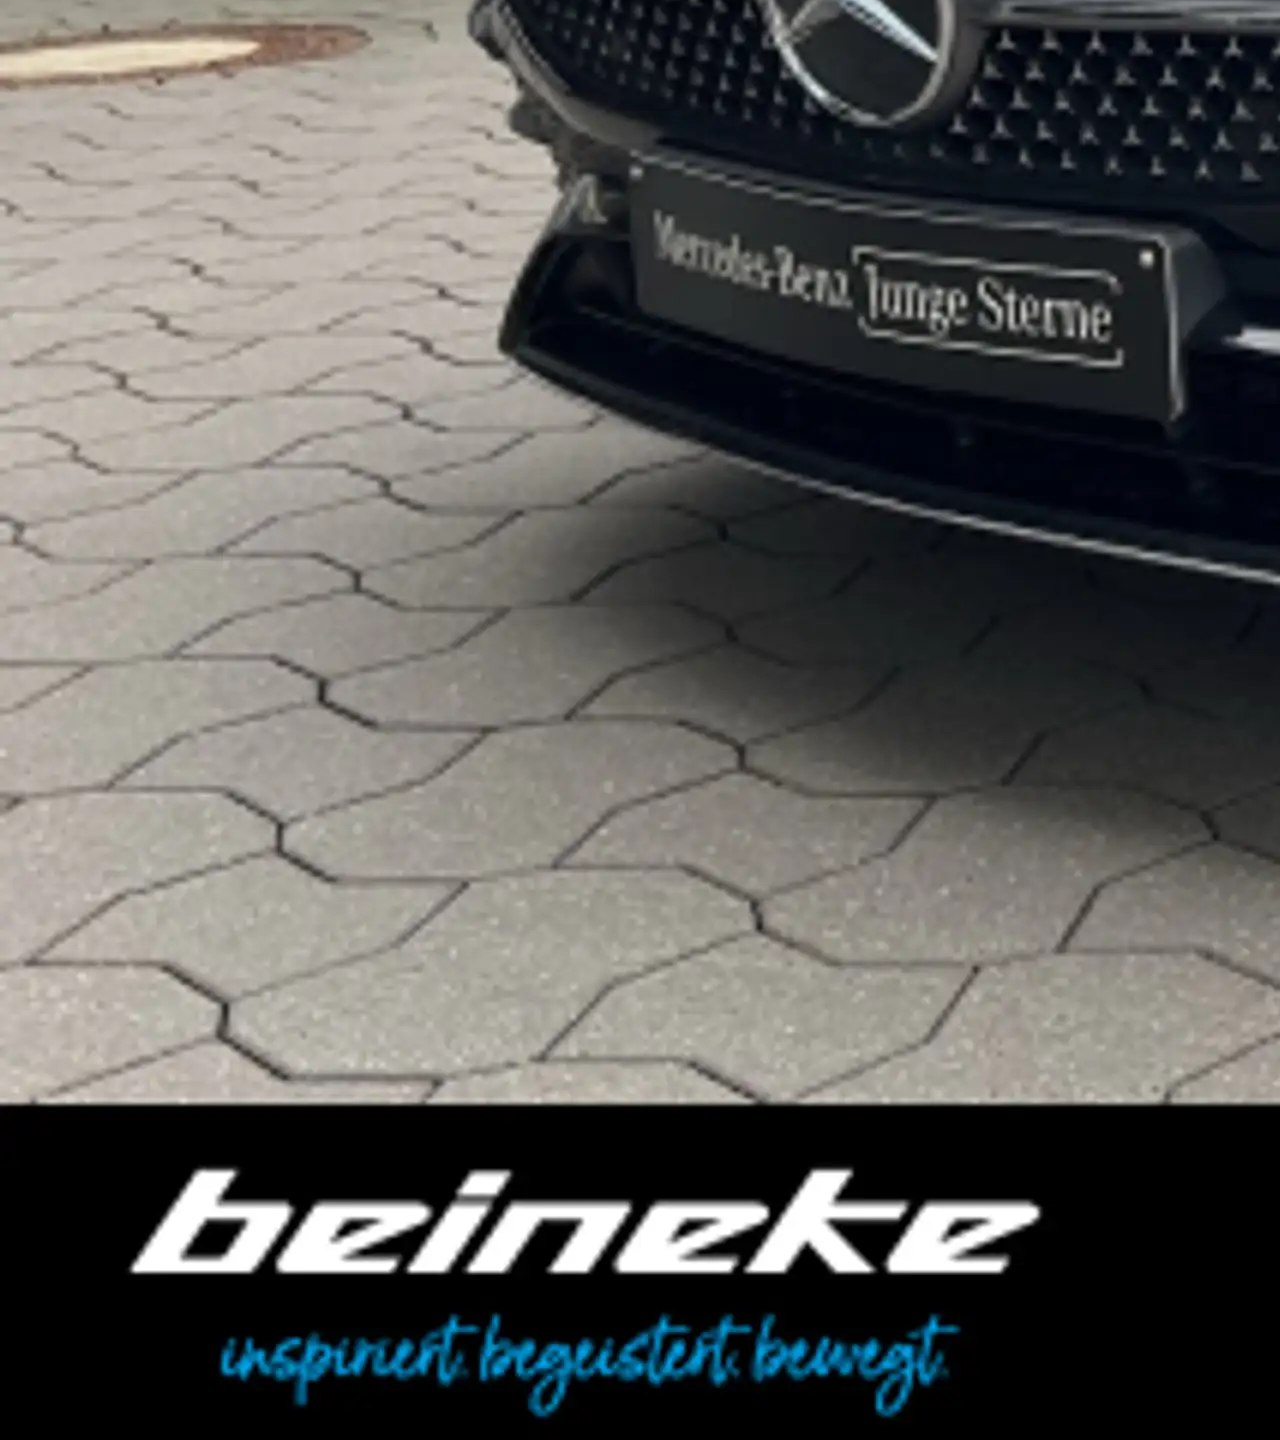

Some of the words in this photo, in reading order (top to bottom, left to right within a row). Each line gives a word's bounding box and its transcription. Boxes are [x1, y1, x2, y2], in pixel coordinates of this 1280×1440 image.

[653, 208, 853, 310] Mercedes-Benz
[863, 263, 969, 336] Junge
[976, 276, 1114, 344] Sterne
